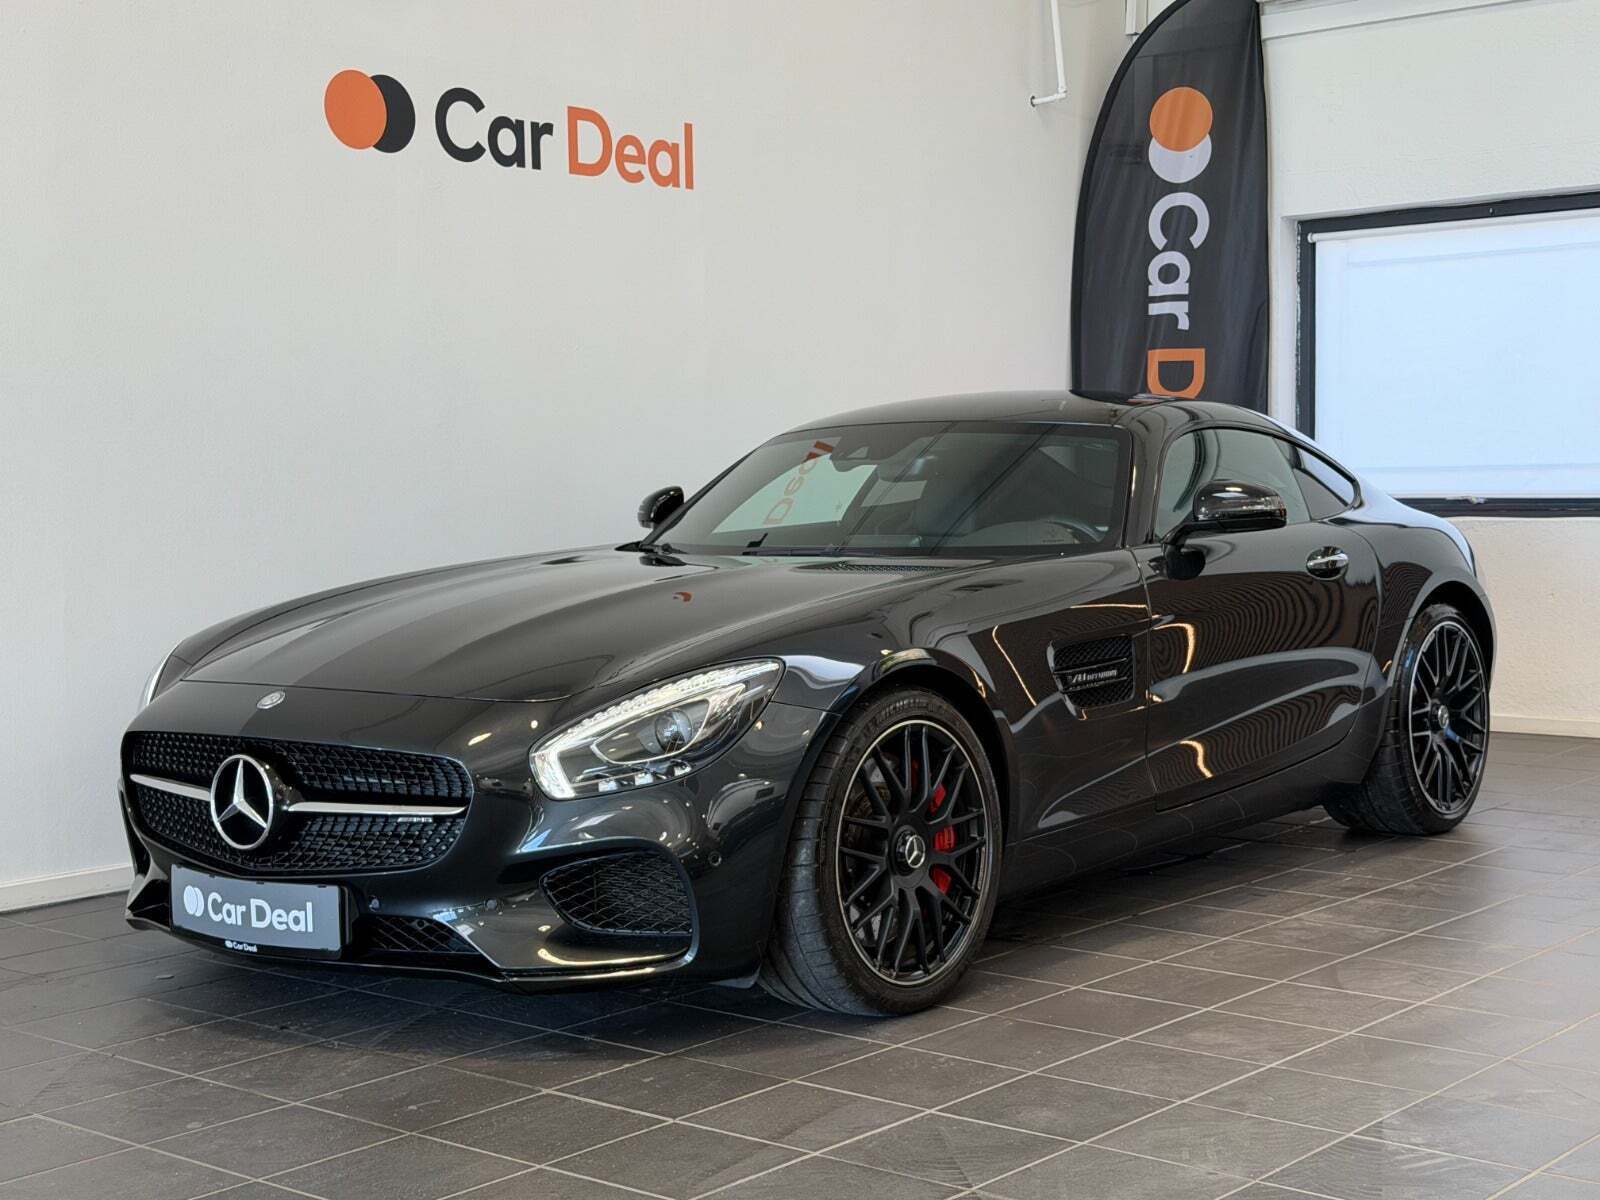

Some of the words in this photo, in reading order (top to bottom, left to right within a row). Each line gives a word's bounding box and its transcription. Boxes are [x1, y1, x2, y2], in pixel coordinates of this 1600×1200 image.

[435, 87, 553, 170] Car
[567, 106, 694, 190] Deal
[1148, 192, 1210, 330] Car
[207, 892, 246, 926] Car
[250, 898, 313, 932] Deal
